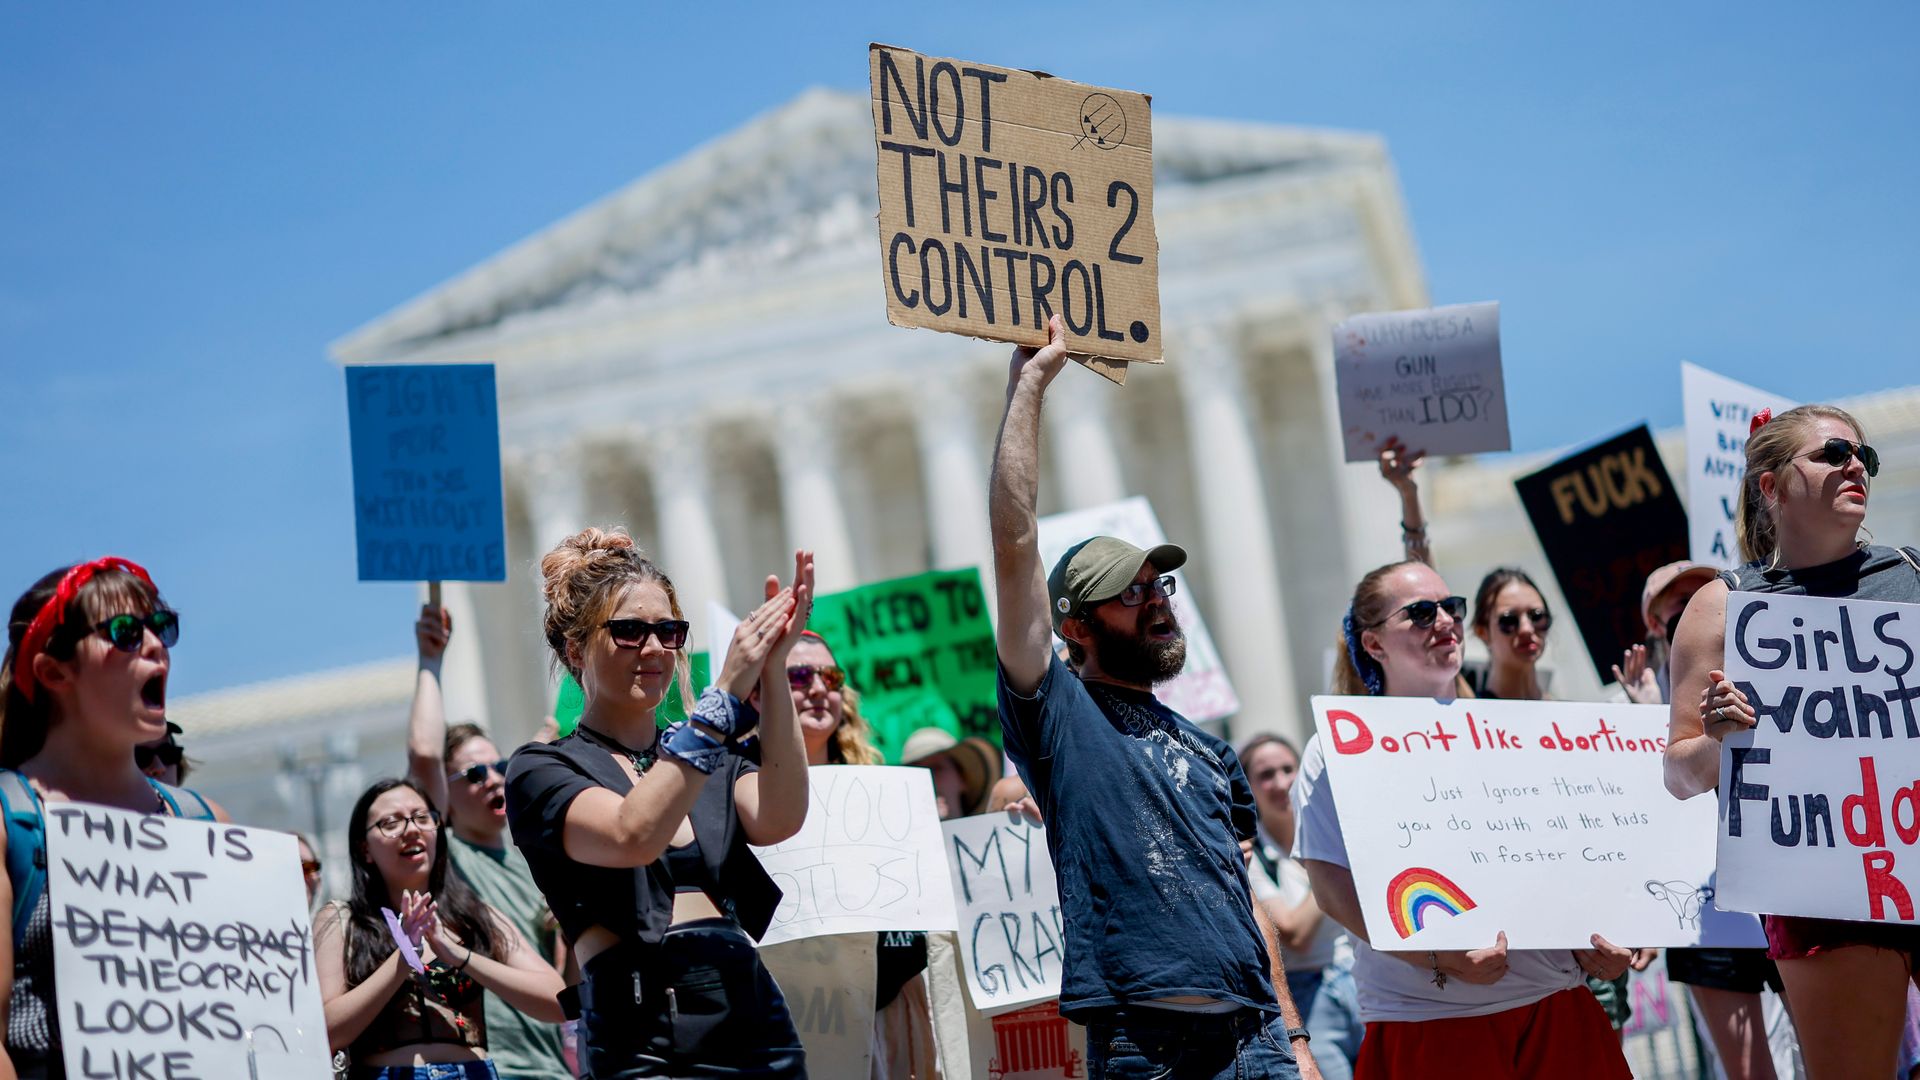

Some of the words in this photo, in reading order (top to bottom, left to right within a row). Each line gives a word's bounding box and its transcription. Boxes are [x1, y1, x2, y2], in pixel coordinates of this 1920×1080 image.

[879, 49, 1008, 152] NOT
[881, 141, 1074, 251] THEIRS
[1107, 181, 1144, 265] 2
[889, 232, 1149, 344] CONTROL.
[1394, 354, 1437, 379] GUN
[356, 368, 494, 417] FIGHT
[388, 421, 449, 461] FOR
[1551, 447, 1663, 525] FUCK
[358, 494, 487, 534] WITHOUT
[842, 589, 932, 648] NEED
[934, 580, 981, 626] TO
[1466, 711, 1520, 751] like
[1422, 776, 1463, 802] Just
[1482, 781, 1540, 804] Ignore
[1552, 777, 1596, 797] them
[1597, 776, 1625, 796] like
[49, 808, 168, 851] THIS
[207, 827, 253, 862] IS
[810, 774, 912, 865] YOU
[1398, 820, 1431, 848] you
[1447, 813, 1472, 832] do
[1486, 816, 1531, 833] with
[1546, 815, 1569, 831] all
[1578, 812, 1604, 830] the
[1611, 811, 1649, 828] kids
[952, 824, 1034, 905] MY
[1498, 845, 1568, 864] foster
[1582, 846, 1627, 863] Care
[62, 857, 208, 905] WHAT
[771, 850, 922, 925] OTUS!
[60, 903, 311, 985] DEMOCRACY
[82, 953, 298, 1015] THEOCRACY
[74, 999, 244, 1041] LOOKS
[82, 1047, 202, 1080] LIKE
